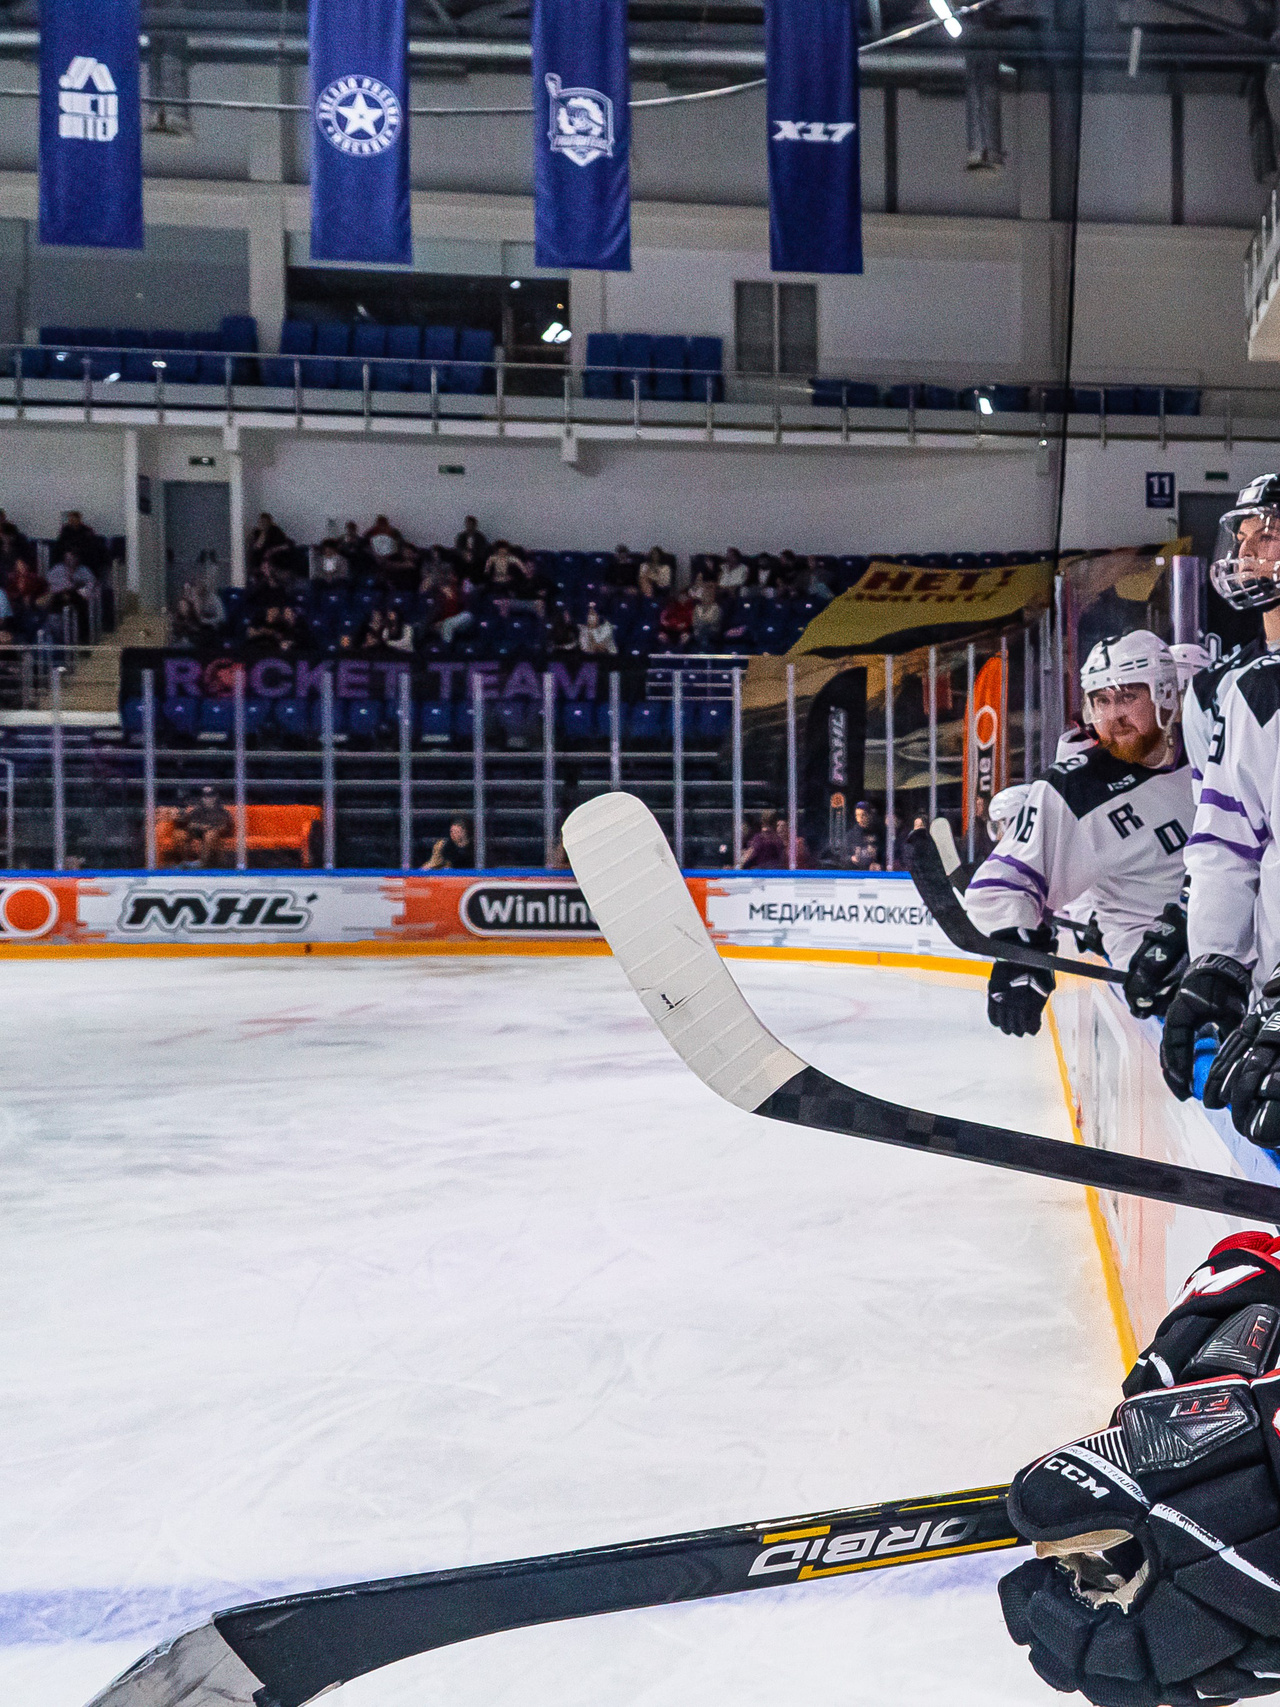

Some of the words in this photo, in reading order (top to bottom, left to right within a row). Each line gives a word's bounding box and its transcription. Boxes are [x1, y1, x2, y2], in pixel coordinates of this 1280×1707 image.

[1149, 476, 1170, 495] 11
[164, 657, 410, 699] ROCKET
[427, 661, 598, 699] TEAM
[126, 897, 304, 925] MHL
[479, 895, 597, 924] Winlin
[749, 899, 859, 924] МЕДИЙНАЯ
[1044, 1457, 1110, 1499] CCM
